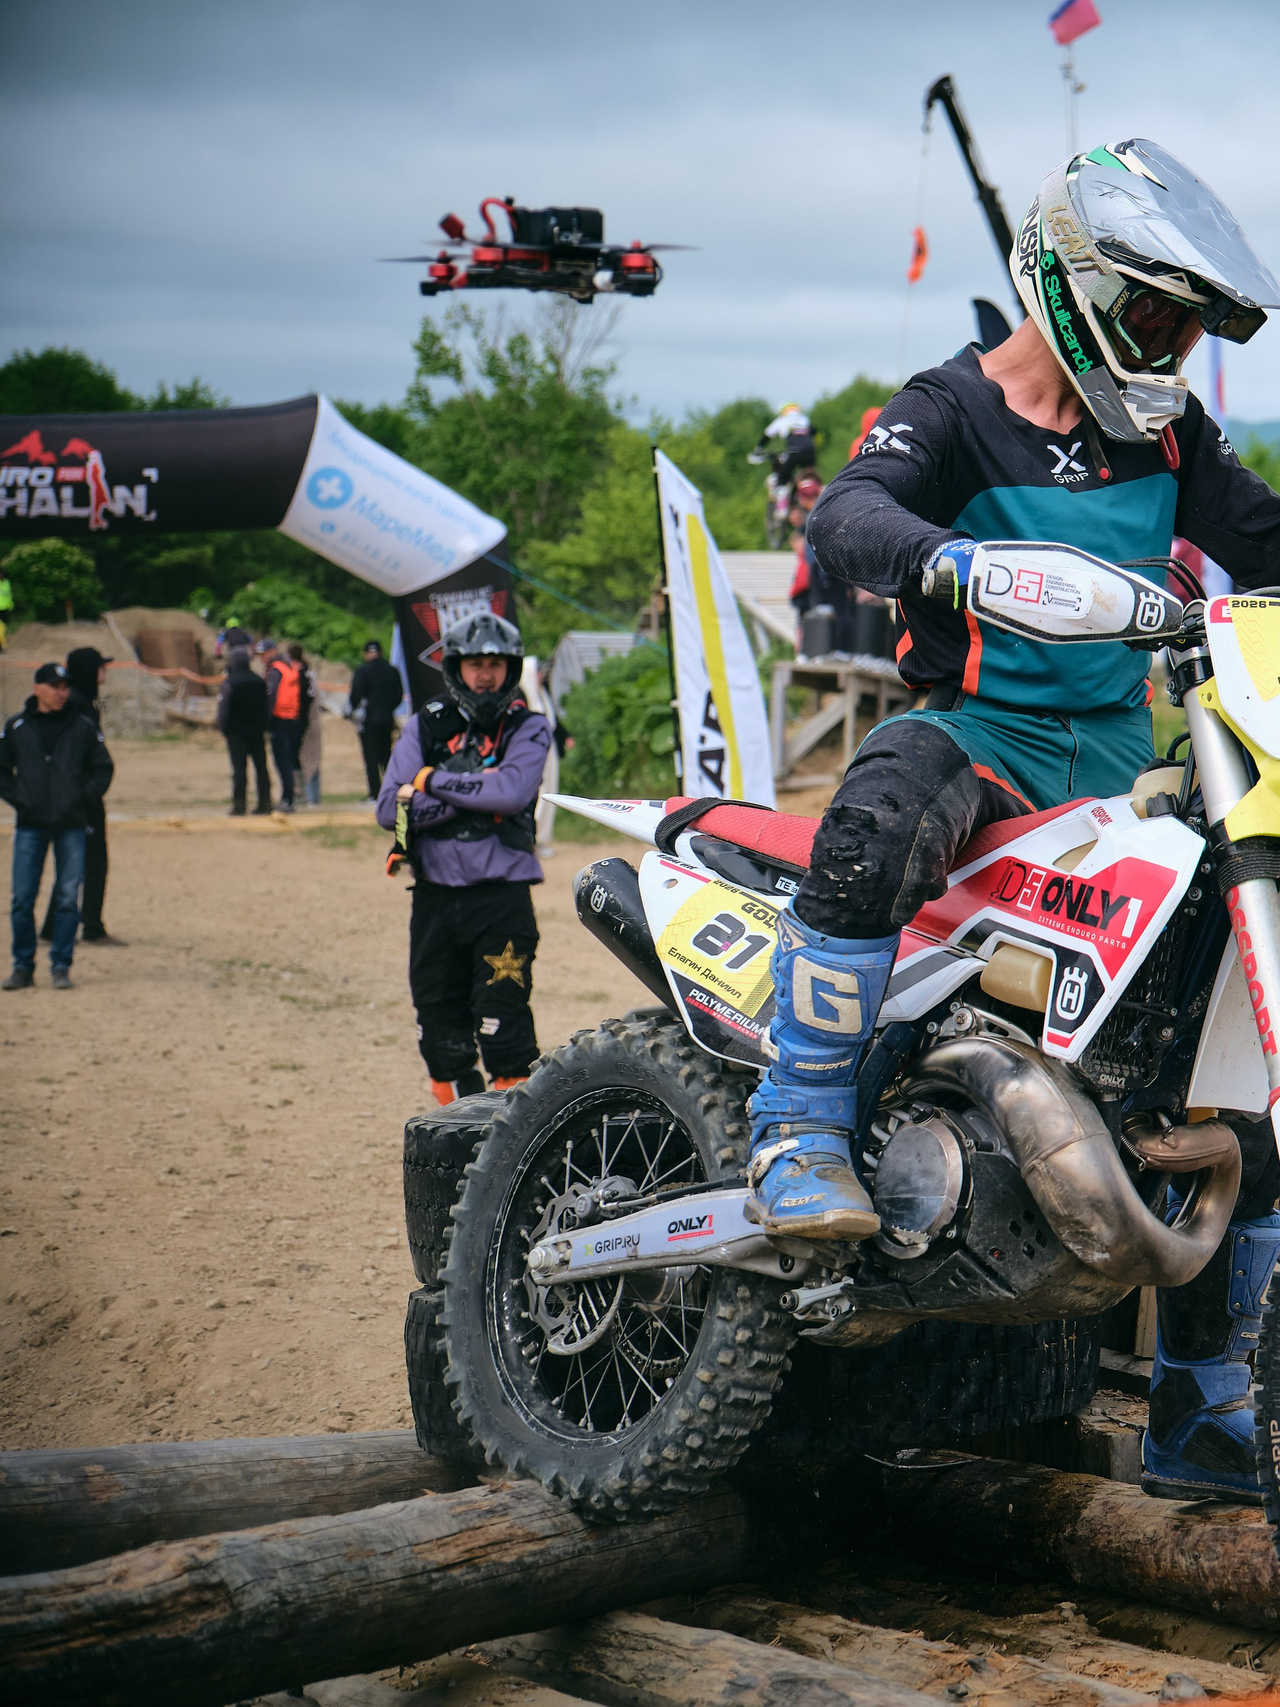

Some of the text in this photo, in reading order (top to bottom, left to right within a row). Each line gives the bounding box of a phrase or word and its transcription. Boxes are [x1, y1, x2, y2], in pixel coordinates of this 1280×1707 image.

[1048, 205, 1106, 276] LEATT
[1045, 274, 1093, 376] Skullcandy
[1053, 472, 1089, 485] GRIP
[741, 902, 779, 931] GOL
[1040, 876, 1142, 938] ONLY1
[692, 913, 771, 969] 21
[1038, 916, 1127, 950] EXTREME ENDURO PARTS
[668, 947, 742, 999] Елагин Даниил
[689, 988, 765, 1036] POLYMERIUM
[667, 1214, 713, 1235] ONLY1
